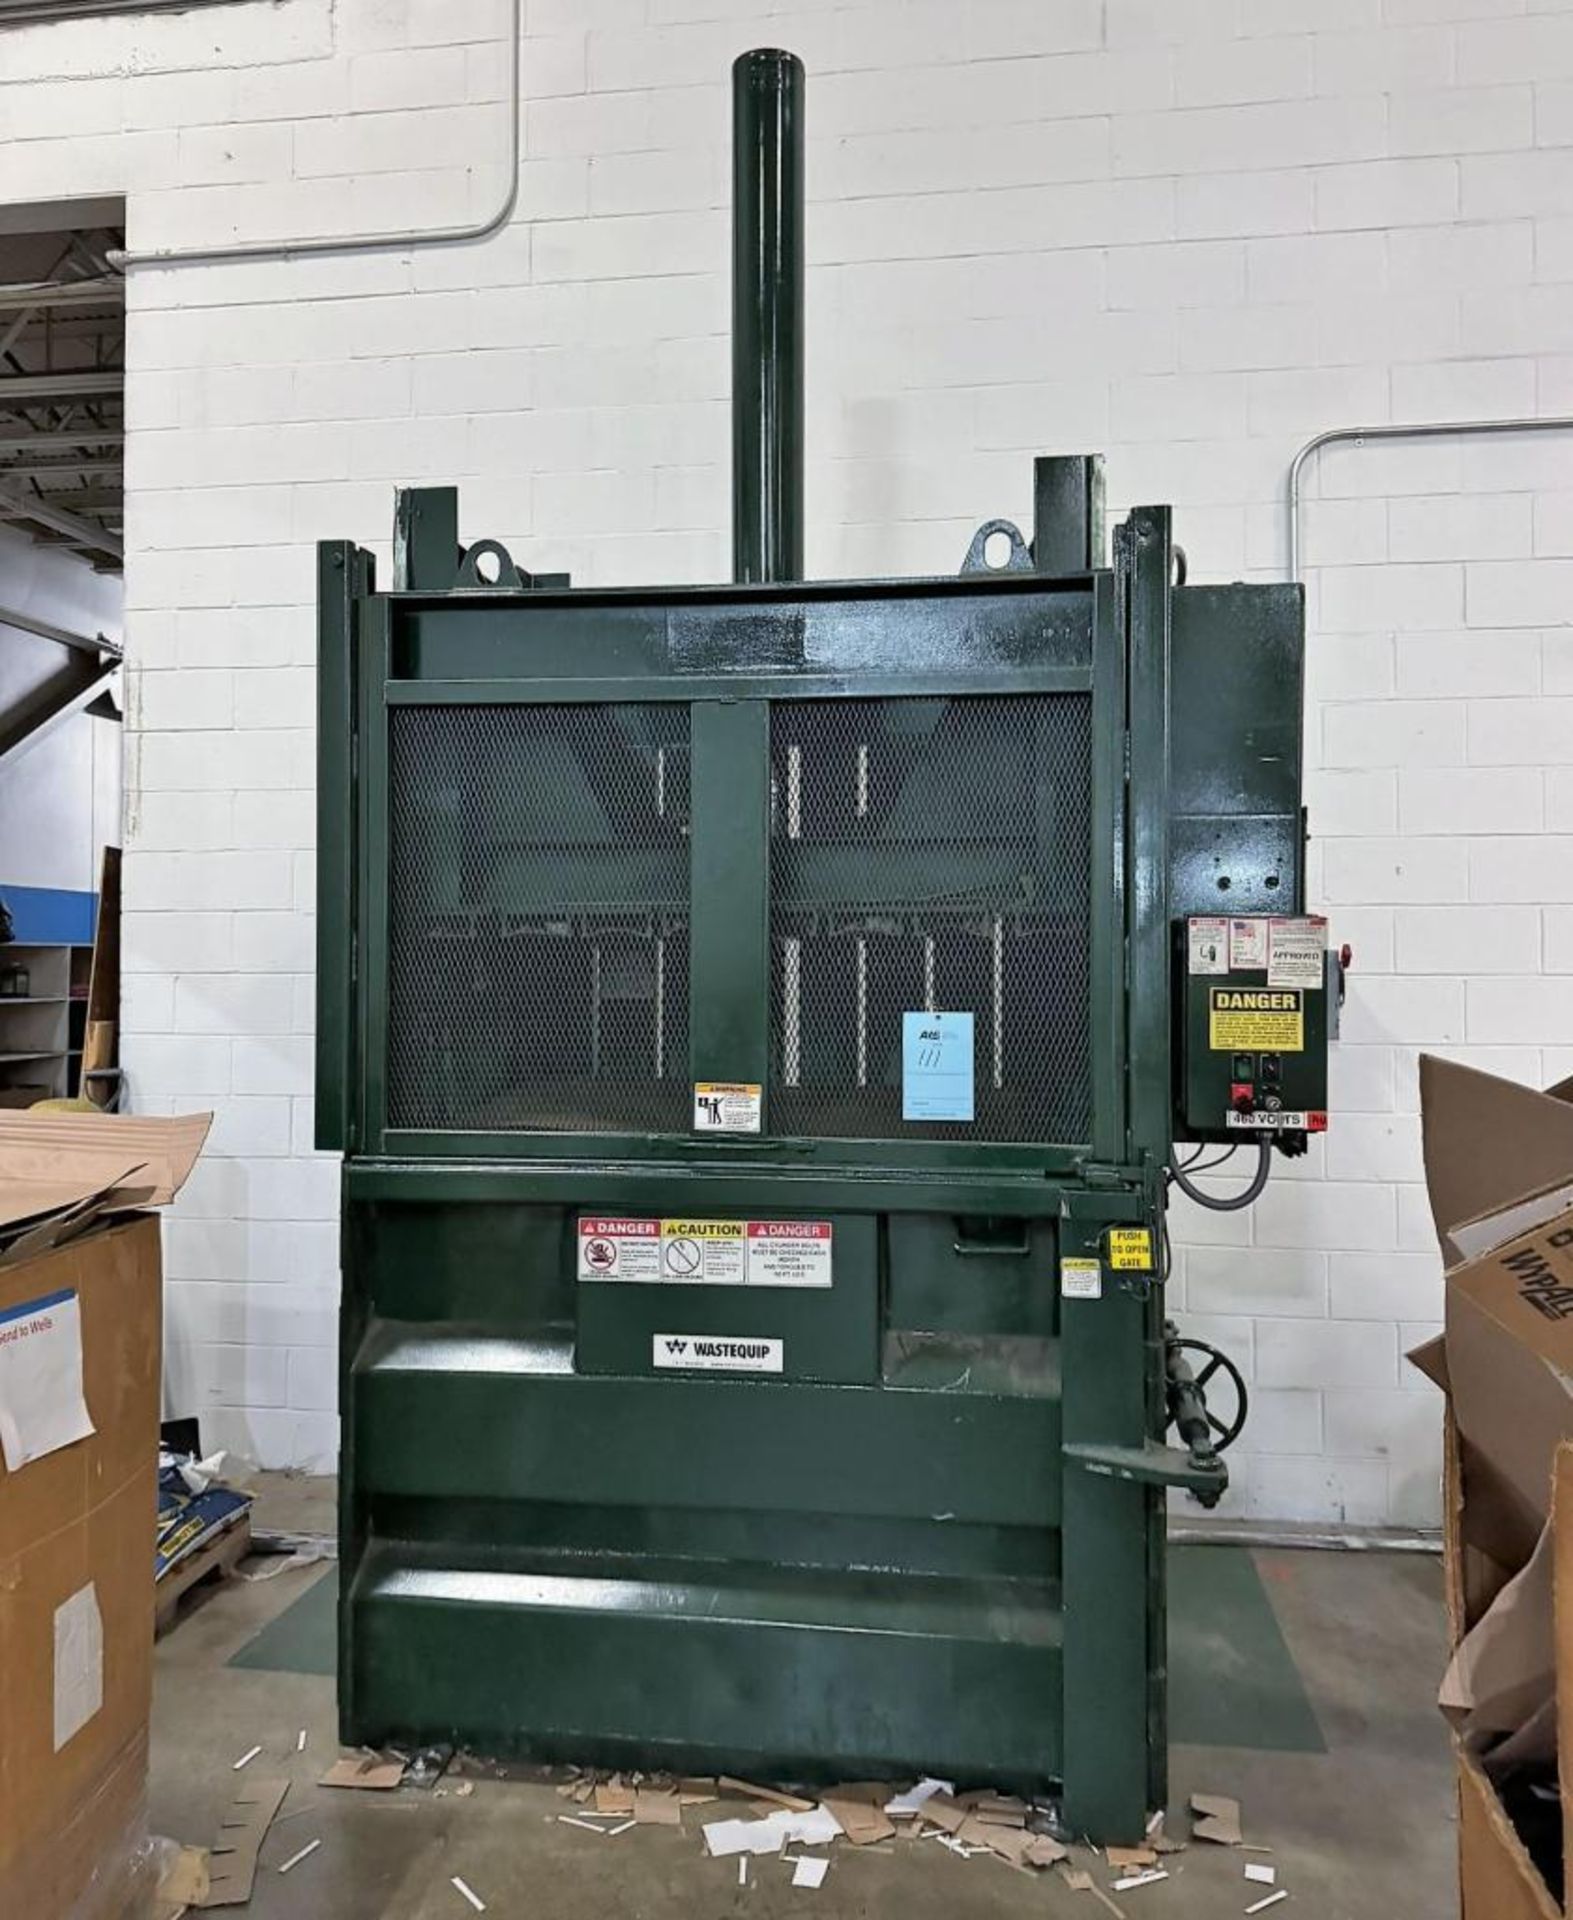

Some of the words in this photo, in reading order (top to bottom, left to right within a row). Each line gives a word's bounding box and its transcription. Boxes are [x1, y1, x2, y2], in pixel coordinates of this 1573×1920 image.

[1216, 992, 1297, 1009] DANGER
[1257, 1113, 1301, 1125] VOTS
[597, 1222, 656, 1235] DANGER
[678, 1223, 742, 1237] CAUTION
[768, 1224, 822, 1237] DANGER
[1117, 1231, 1142, 1241] PUSH
[1112, 1246, 1124, 1254] TO
[1125, 1245, 1149, 1255] OPEN
[1119, 1258, 1142, 1267] GATE
[30, 1317, 53, 1334] Wells
[693, 1342, 770, 1360] WASTEQUIP
